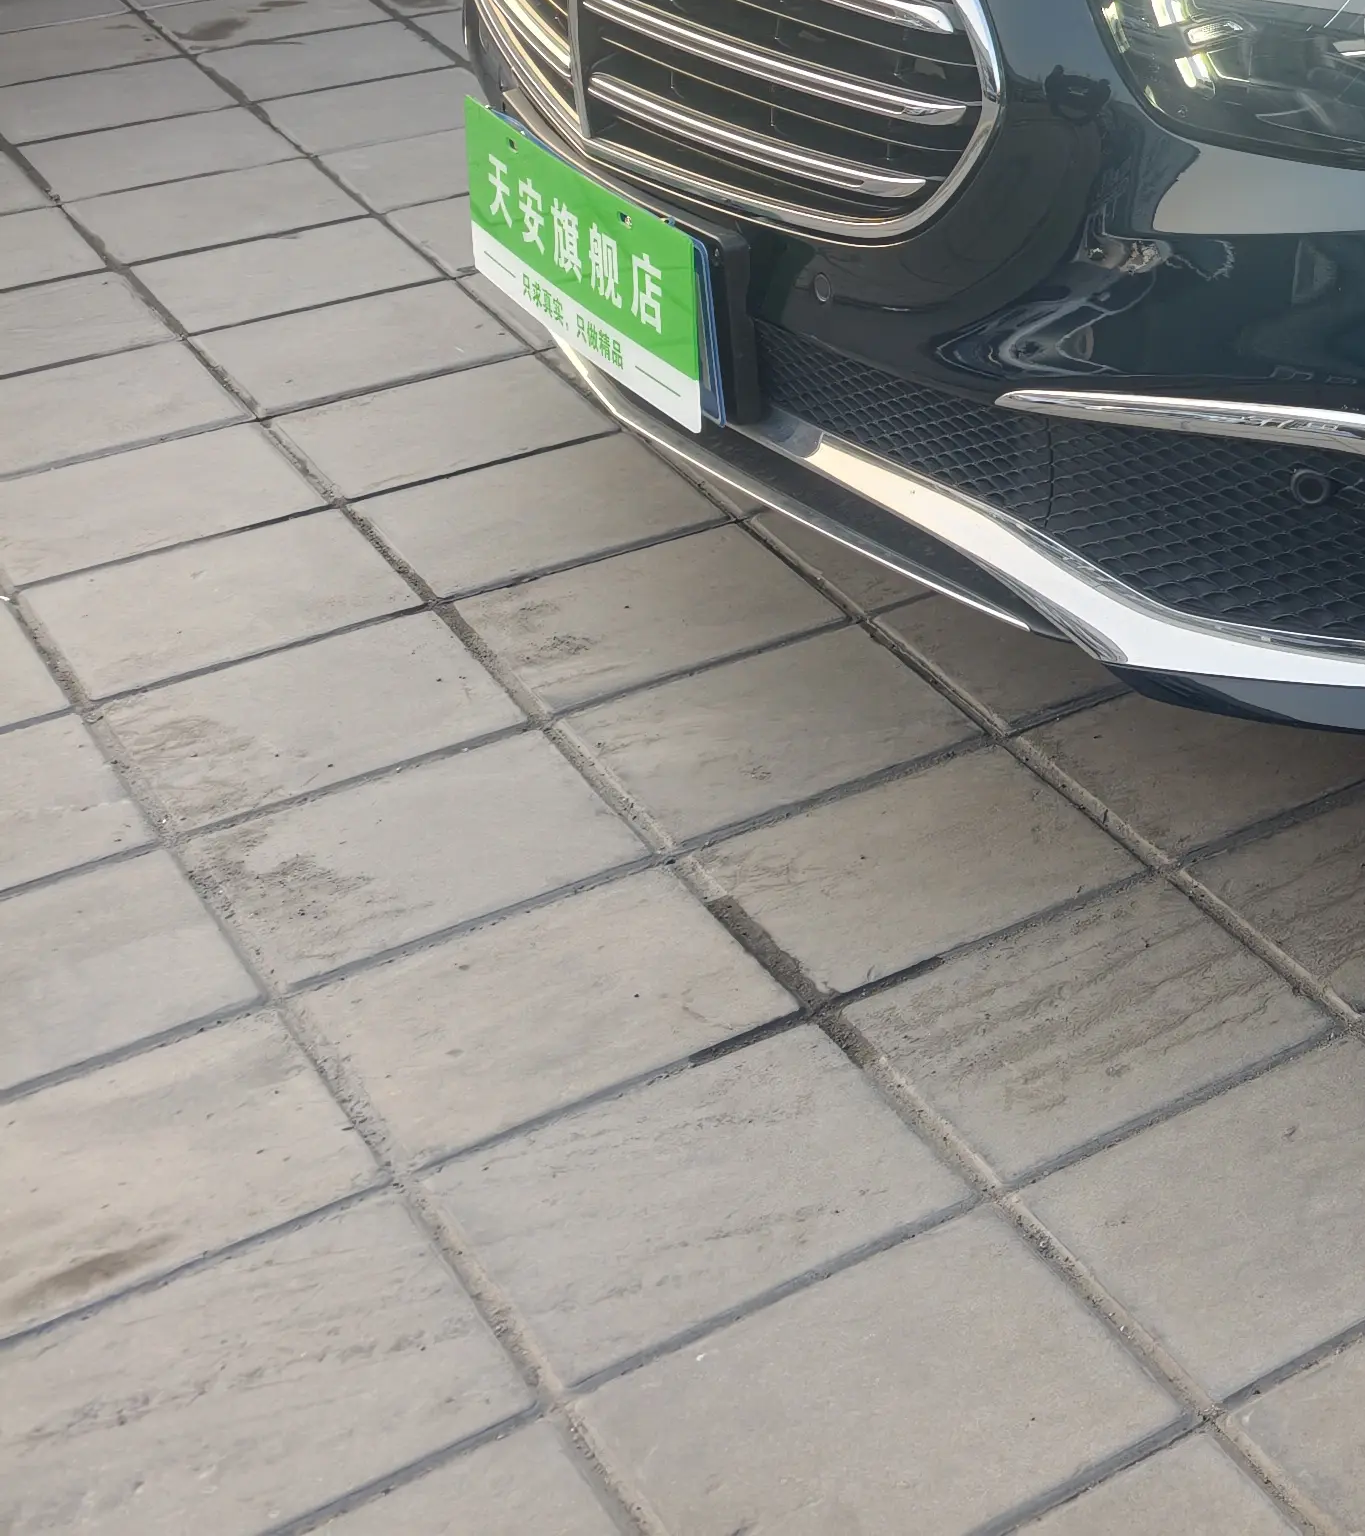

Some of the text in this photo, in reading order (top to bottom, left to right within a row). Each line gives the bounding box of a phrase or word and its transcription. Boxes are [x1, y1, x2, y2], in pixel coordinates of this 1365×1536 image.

[488, 153, 662, 334] 天安旗舰店
